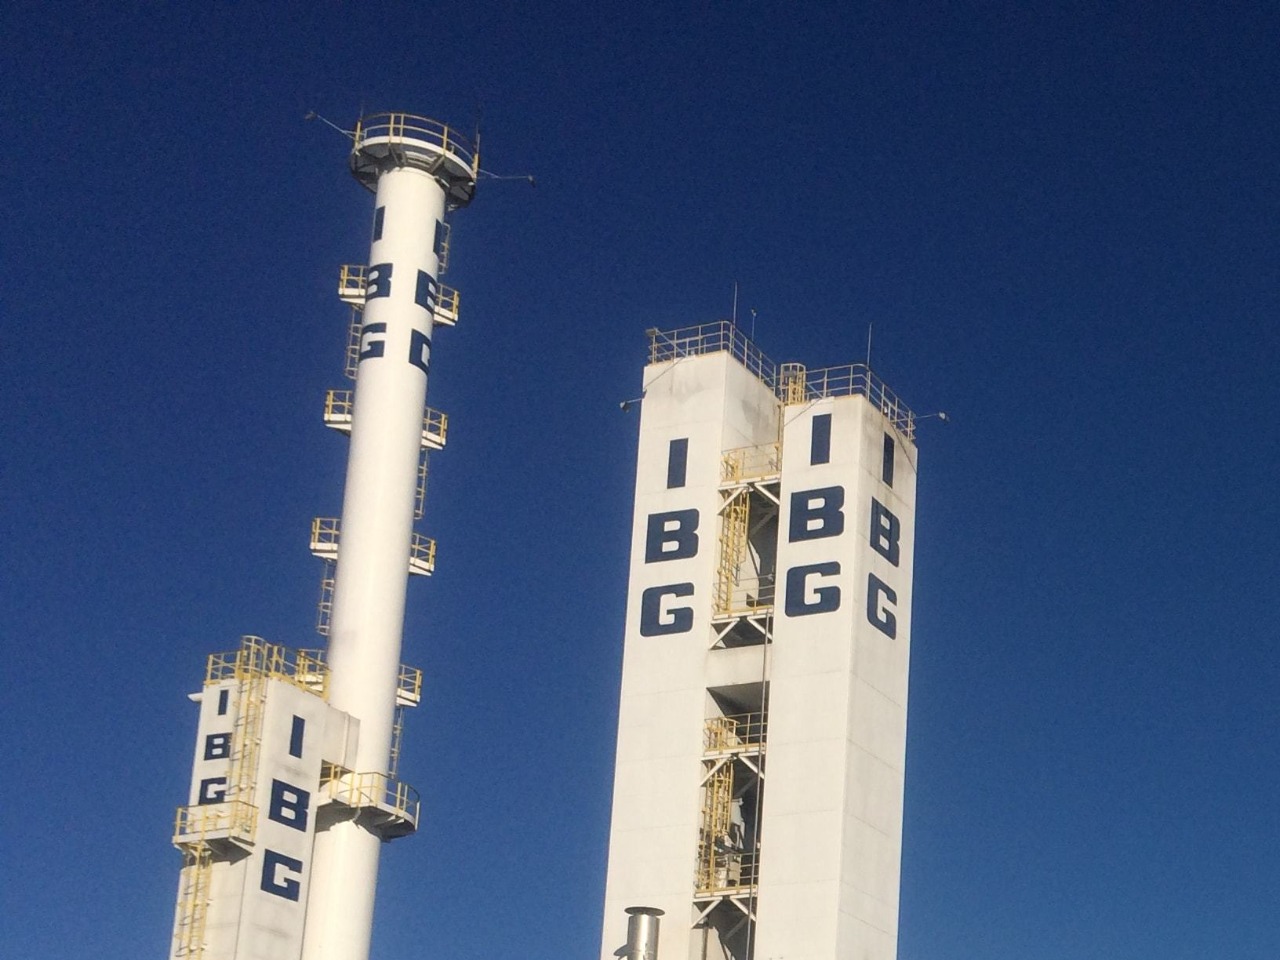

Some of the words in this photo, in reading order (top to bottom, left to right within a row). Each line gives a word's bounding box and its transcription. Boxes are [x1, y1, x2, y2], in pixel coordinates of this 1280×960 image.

[640, 437, 699, 637] IBG
[784, 413, 845, 617] IBG
[866, 431, 901, 640] IBG
[198, 689, 232, 805] IBG
[261, 714, 310, 902] IBG
